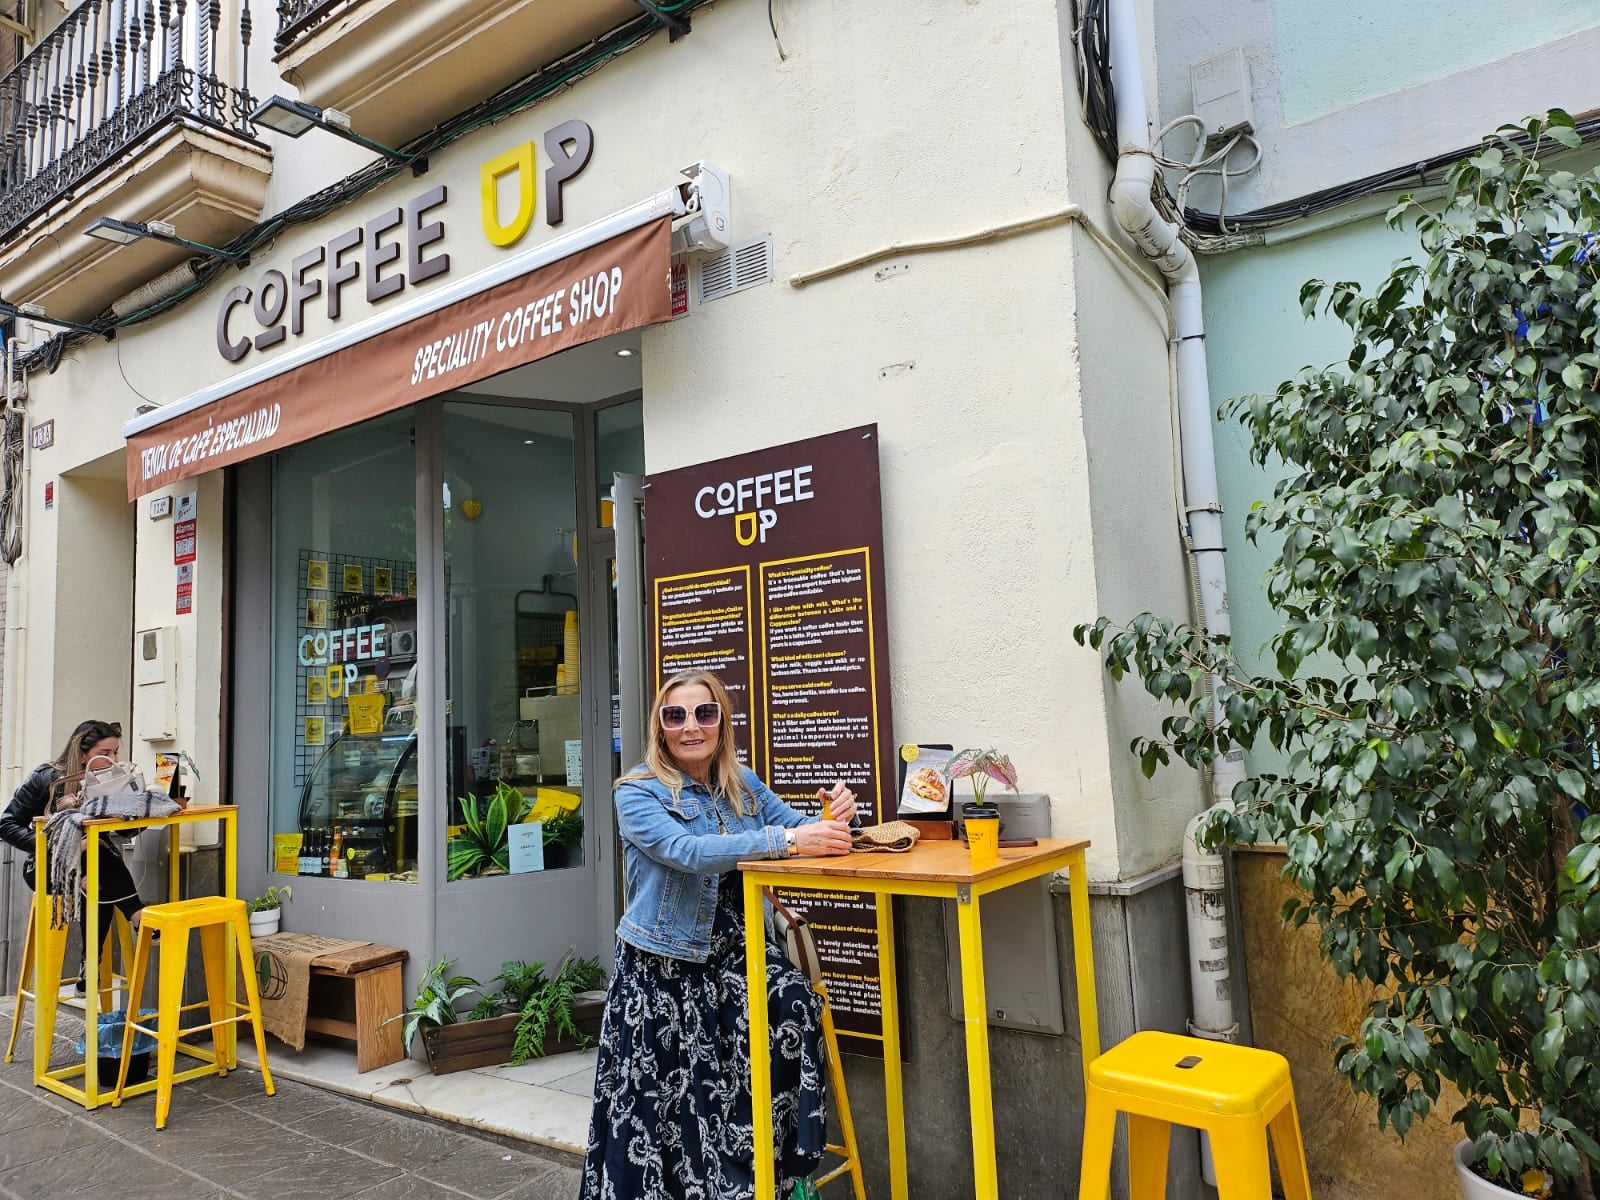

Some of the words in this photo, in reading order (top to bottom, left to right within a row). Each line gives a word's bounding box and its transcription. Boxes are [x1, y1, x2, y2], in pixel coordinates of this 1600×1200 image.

[217, 185, 450, 363] COFFEE
[480, 118, 595, 248] UP
[411, 317, 495, 386] SPECIALITY
[496, 288, 565, 352] COFFEE
[570, 266, 622, 326] SHOP
[141, 442, 171, 481] TIENDA
[169, 439, 185, 470] DE
[208, 402, 281, 457] ESPECIALIDAD
[694, 465, 814, 519] COFFEE
[735, 508, 778, 546] UP
[299, 623, 386, 667] COFFEE
[327, 663, 358, 699] UP
[824, 939, 841, 948] lovely
